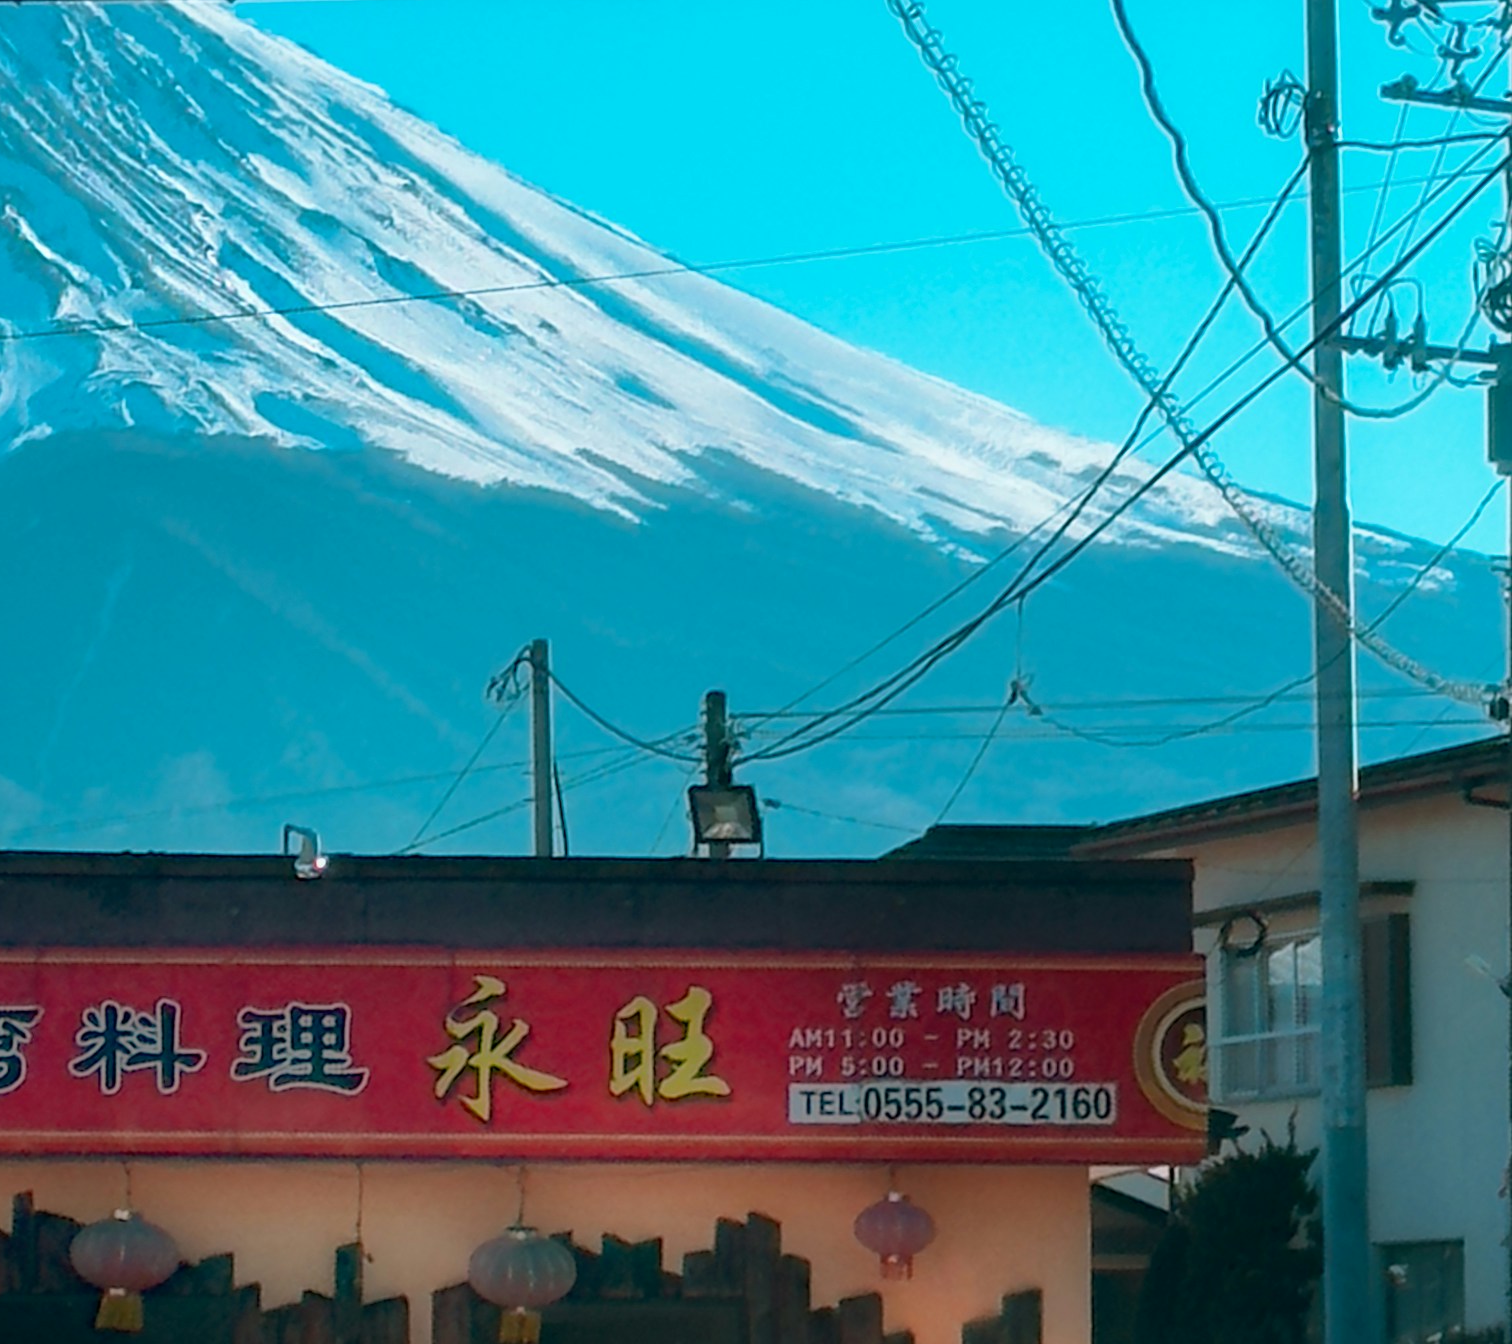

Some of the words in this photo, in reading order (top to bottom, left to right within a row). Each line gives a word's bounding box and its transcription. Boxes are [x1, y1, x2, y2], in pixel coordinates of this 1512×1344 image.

[837, 982, 1027, 1020] 営業時間
[427, 974, 732, 1124] 永旺
[789, 1028, 905, 1049] AM11:00
